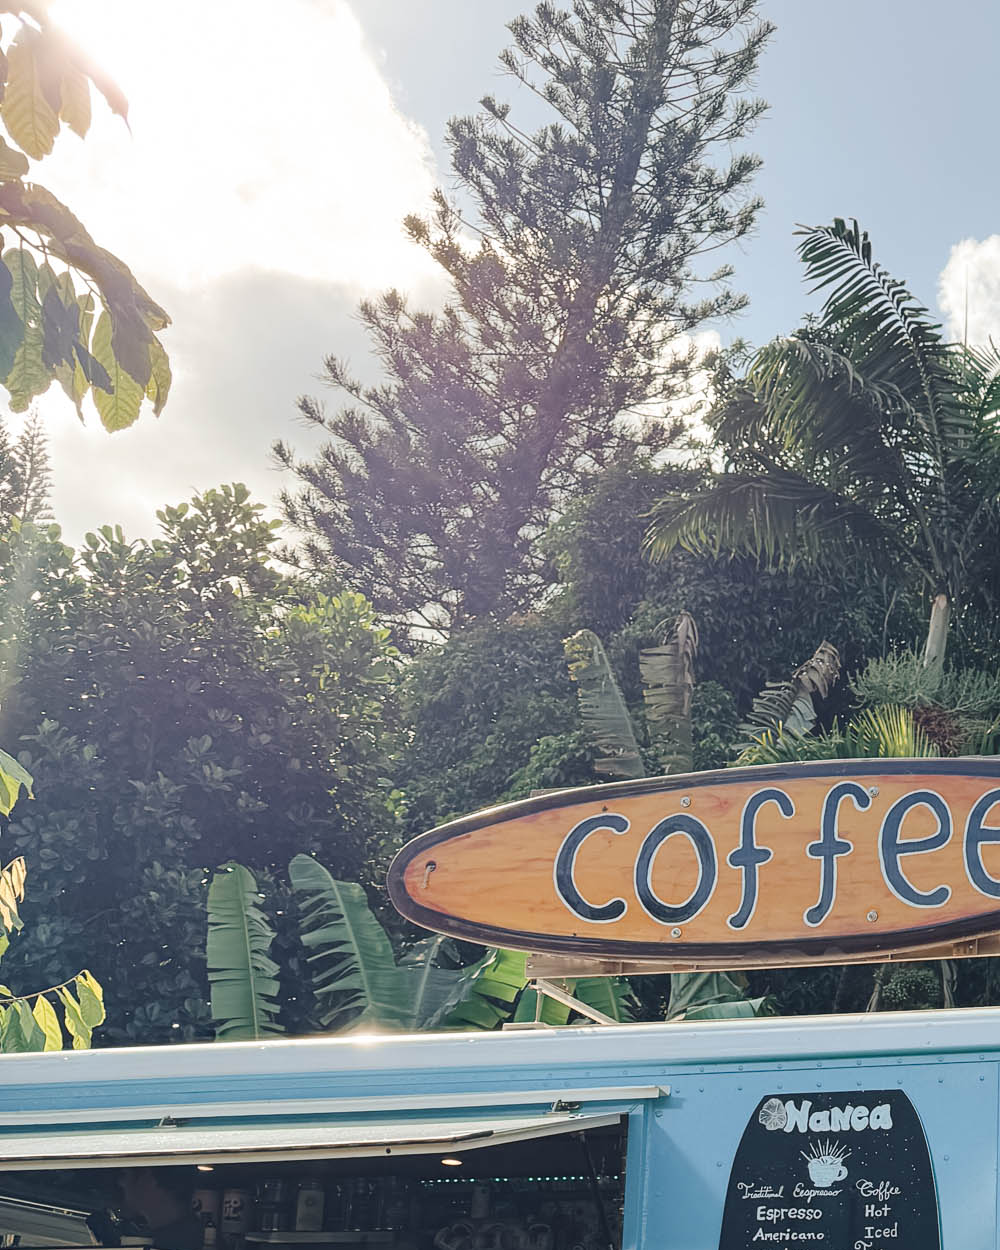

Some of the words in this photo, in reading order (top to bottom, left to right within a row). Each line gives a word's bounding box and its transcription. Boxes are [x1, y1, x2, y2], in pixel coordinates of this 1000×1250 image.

[856, 1179, 901, 1201] Coffee
[756, 1206, 822, 1224] Espresso
[865, 1204, 891, 1217] Hot
[752, 1228, 824, 1242] Americano
[864, 1222, 898, 1239] Iced
